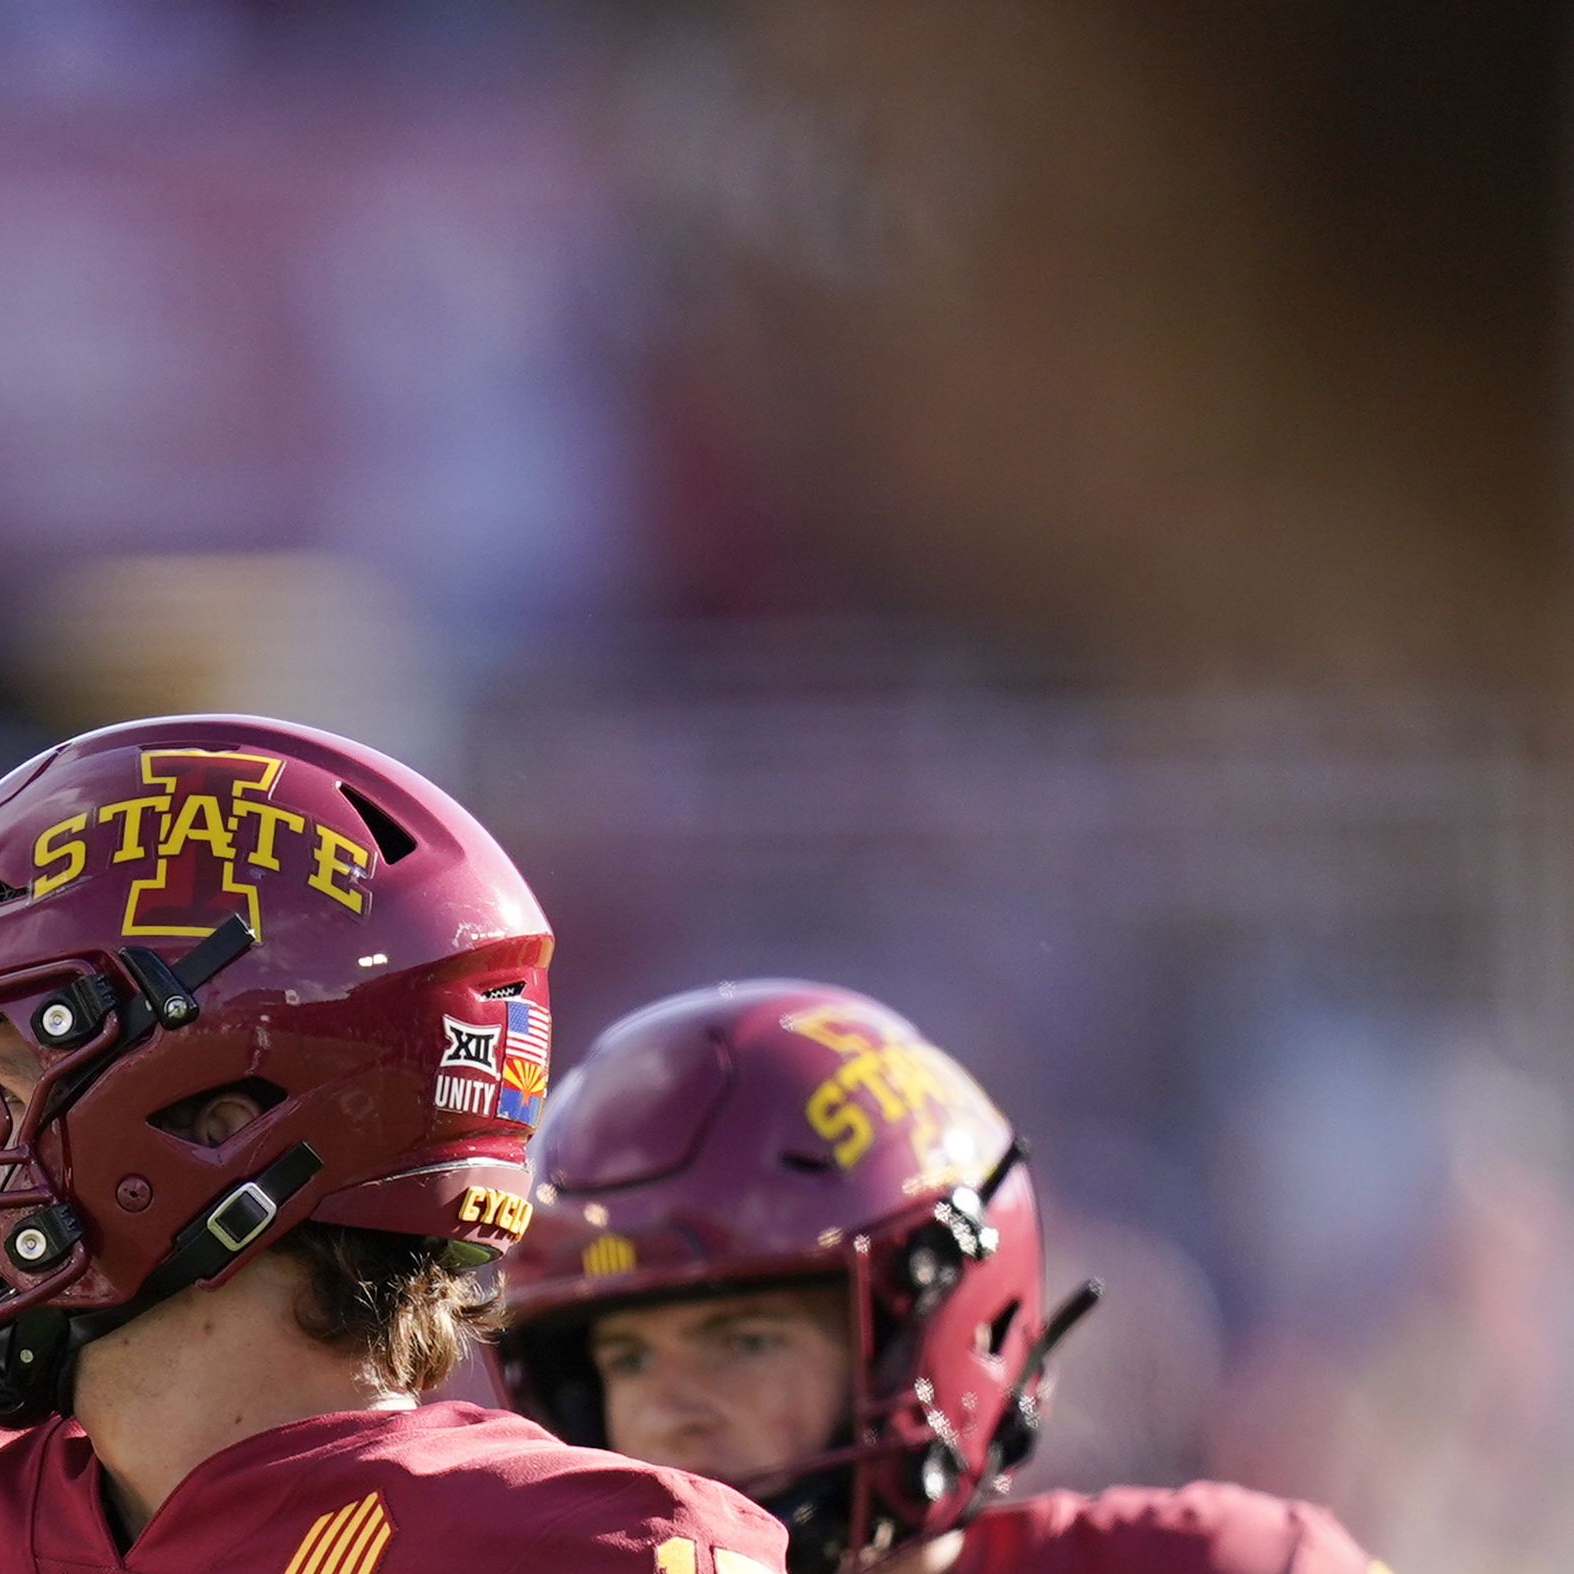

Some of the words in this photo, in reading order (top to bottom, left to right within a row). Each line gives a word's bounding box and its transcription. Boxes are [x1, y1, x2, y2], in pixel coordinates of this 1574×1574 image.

[31, 795, 376, 914] STATE
[446, 1025, 495, 1068] XII
[435, 1075, 496, 1116] UNITY
